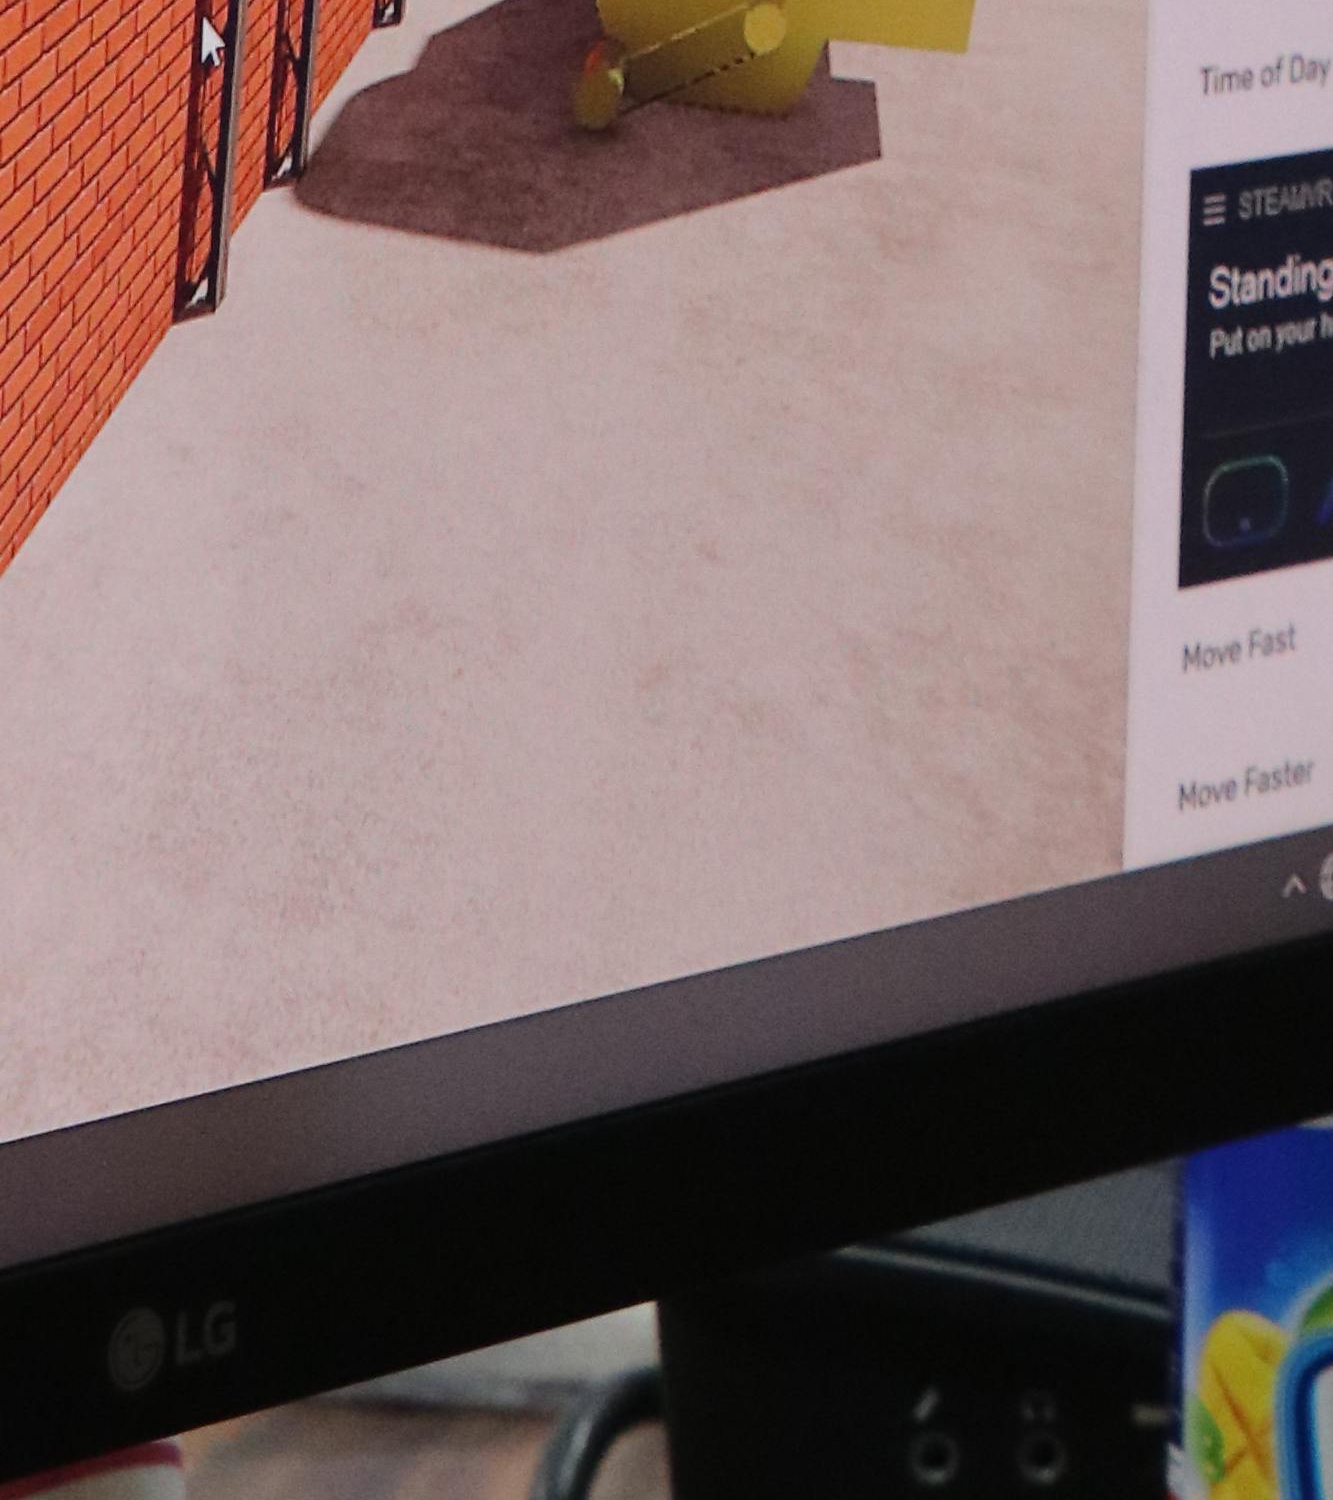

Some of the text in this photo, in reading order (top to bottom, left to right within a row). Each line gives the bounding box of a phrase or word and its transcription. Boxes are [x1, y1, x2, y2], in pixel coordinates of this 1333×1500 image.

[1202, 52, 1332, 95] Time of Day
[1209, 325, 1243, 361] Put
[1247, 327, 1272, 352] on
[1275, 315, 1317, 353] your
[1183, 622, 1296, 673] Move Fast
[1178, 760, 1314, 811] Move Faster
[176, 1301, 236, 1367] LG
